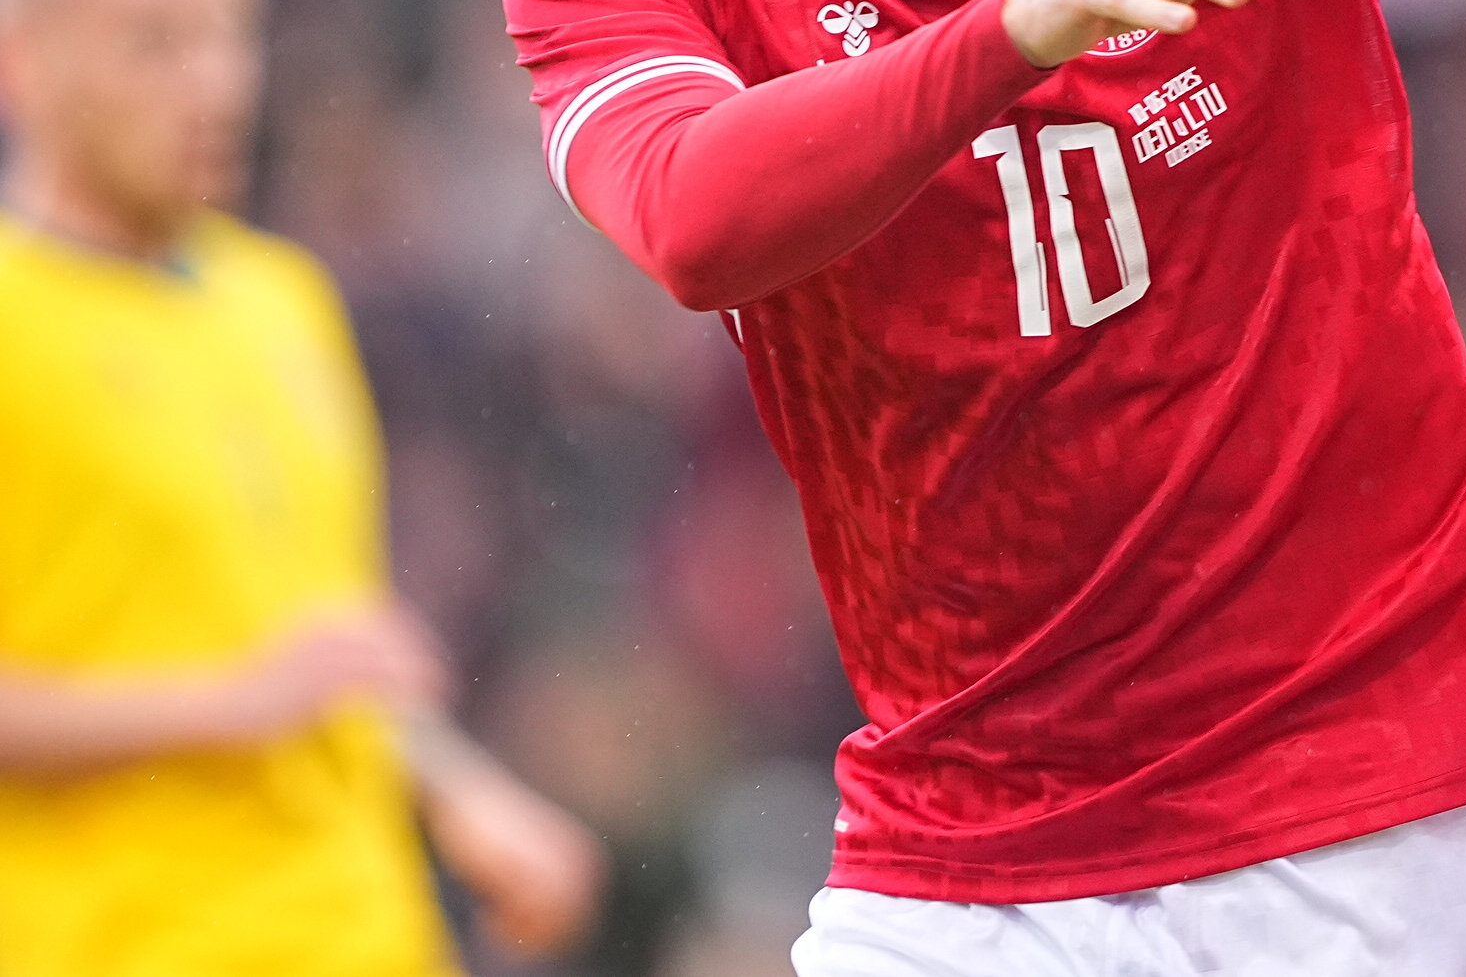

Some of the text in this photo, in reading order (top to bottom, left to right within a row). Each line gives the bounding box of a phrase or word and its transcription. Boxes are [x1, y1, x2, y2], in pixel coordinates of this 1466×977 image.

[1105, 29, 1148, 51] 188
[1178, 83, 1228, 131] LTU
[971, 122, 1151, 337] 10
